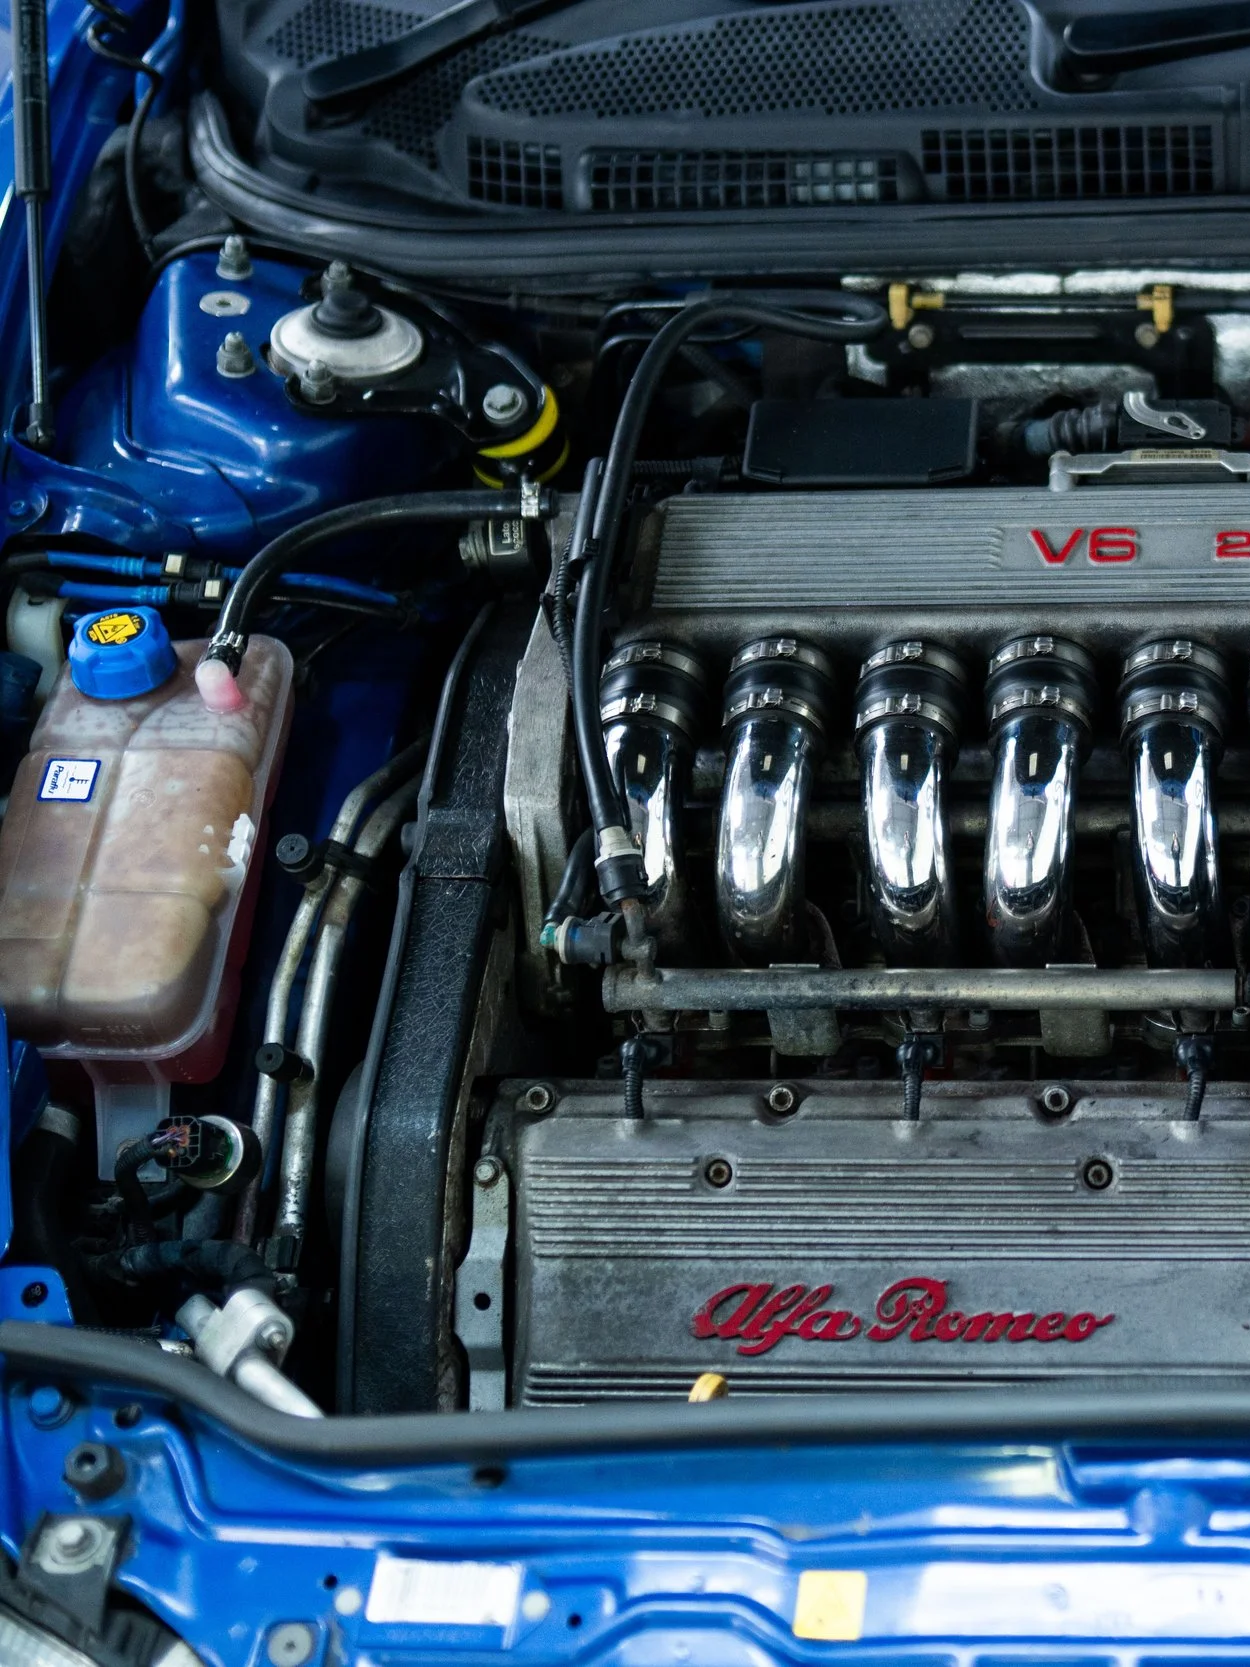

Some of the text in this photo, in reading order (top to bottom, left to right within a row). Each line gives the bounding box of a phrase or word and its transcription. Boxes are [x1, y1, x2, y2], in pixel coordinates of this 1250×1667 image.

[502, 522, 511, 544] Lato
[512, 520, 520, 550] scocc
[1029, 528, 1138, 566] V6
[690, 1276, 1116, 1356] Alfa Romeo
